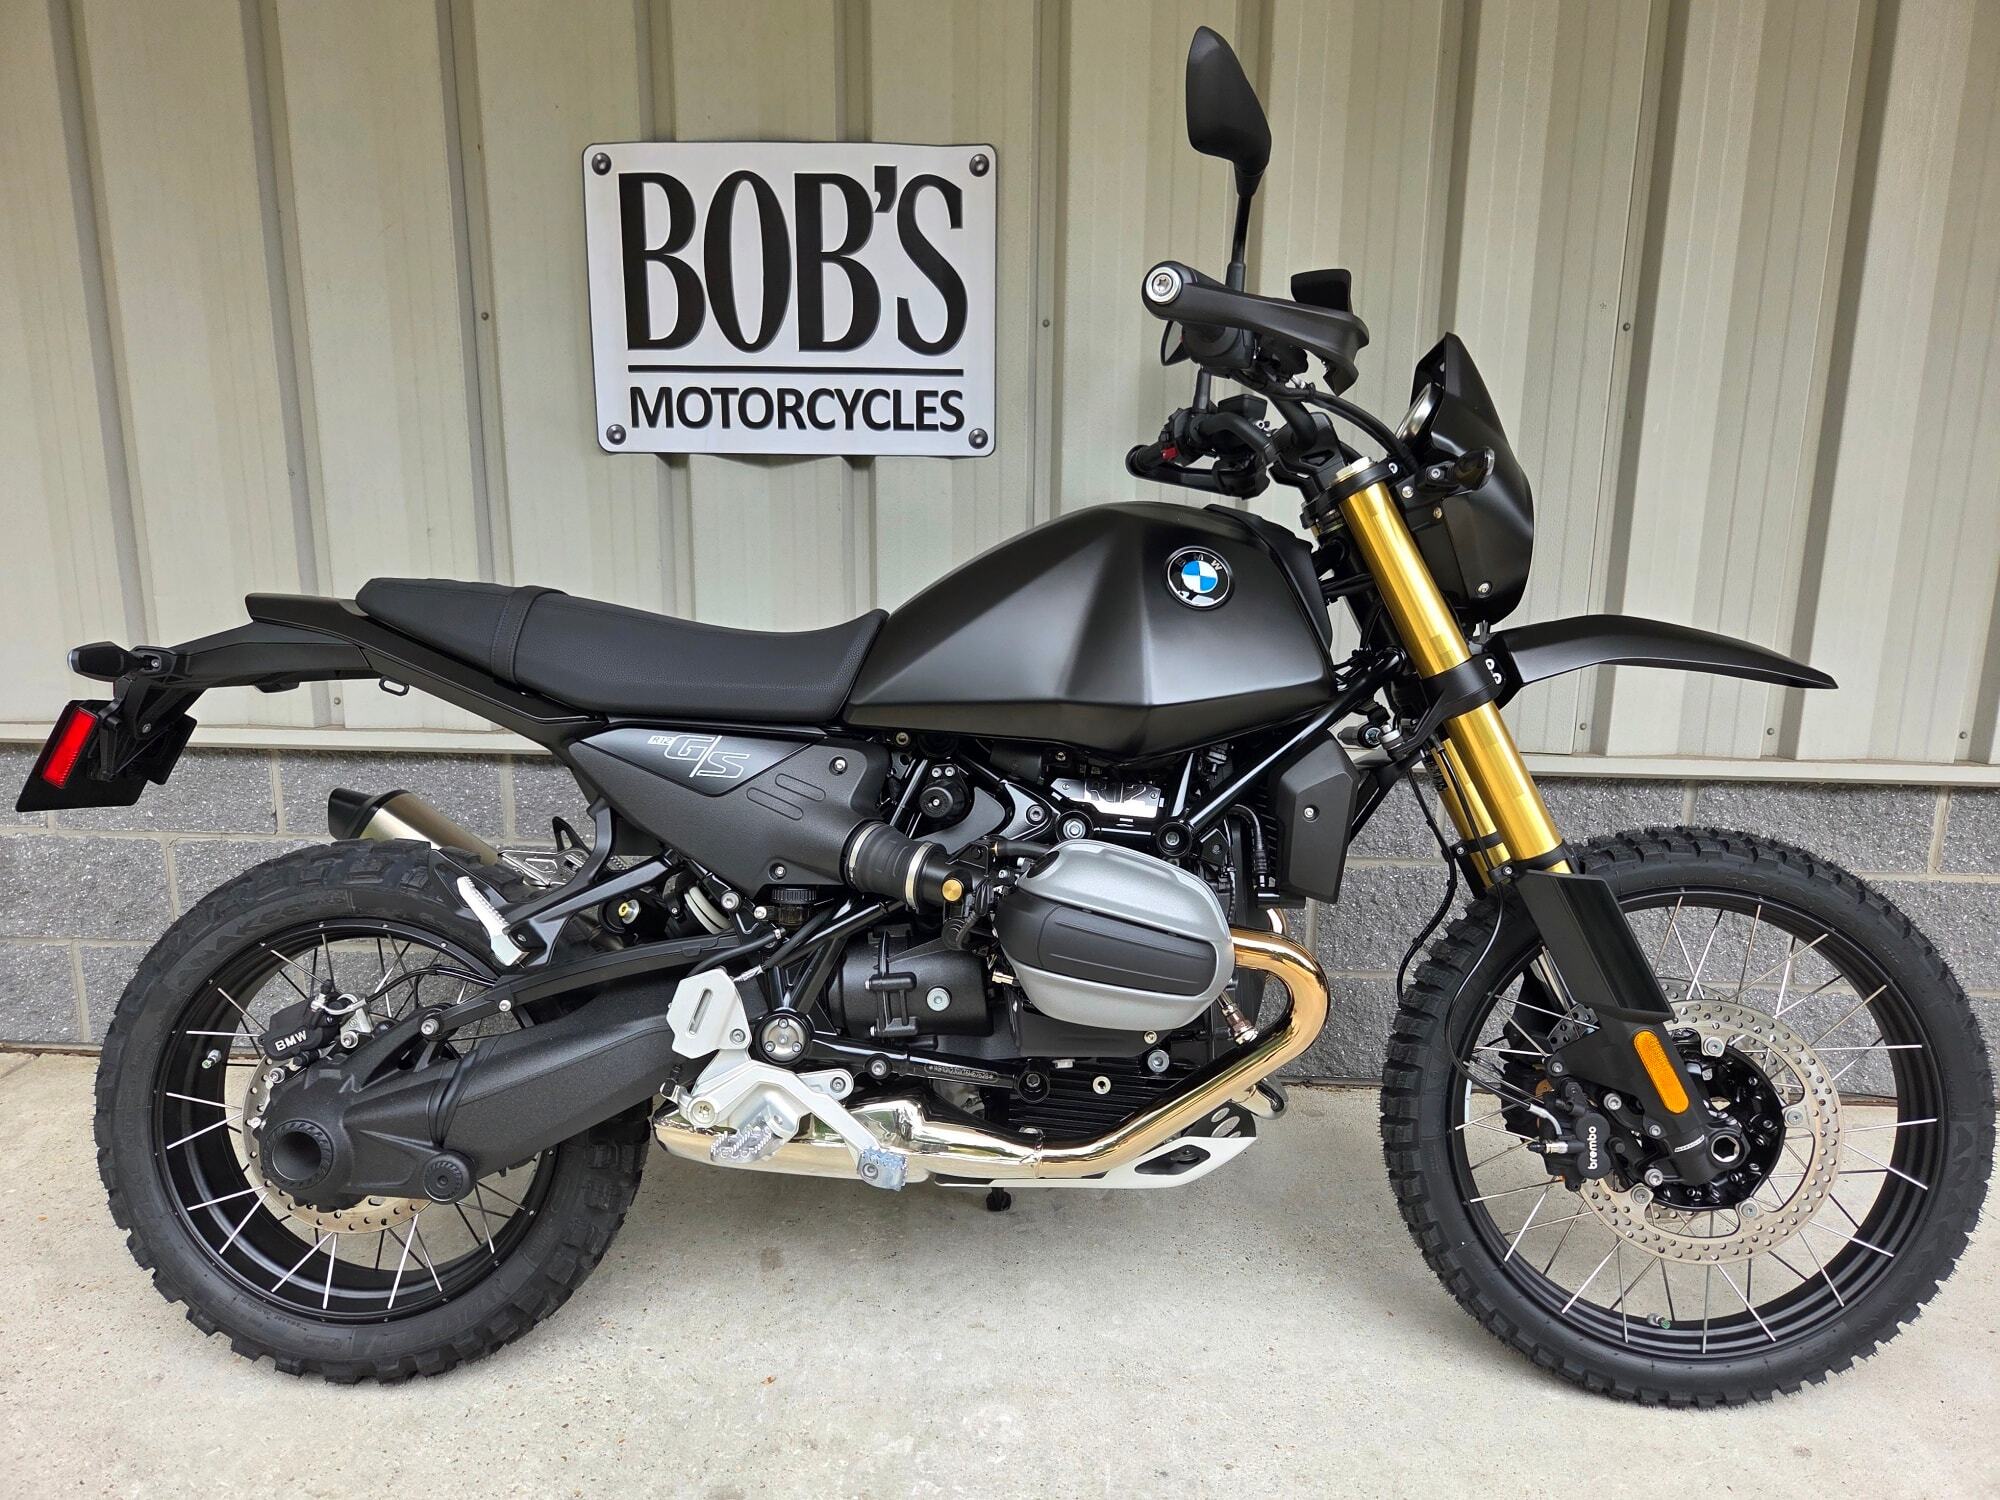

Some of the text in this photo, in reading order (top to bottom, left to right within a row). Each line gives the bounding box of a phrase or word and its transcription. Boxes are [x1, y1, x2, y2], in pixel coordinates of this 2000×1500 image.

[618, 165, 968, 356] BOB'S
[629, 386, 965, 431] MOTORCYCLES
[274, 1030, 308, 1051] BMW
[1587, 1125, 1597, 1170] brembo
